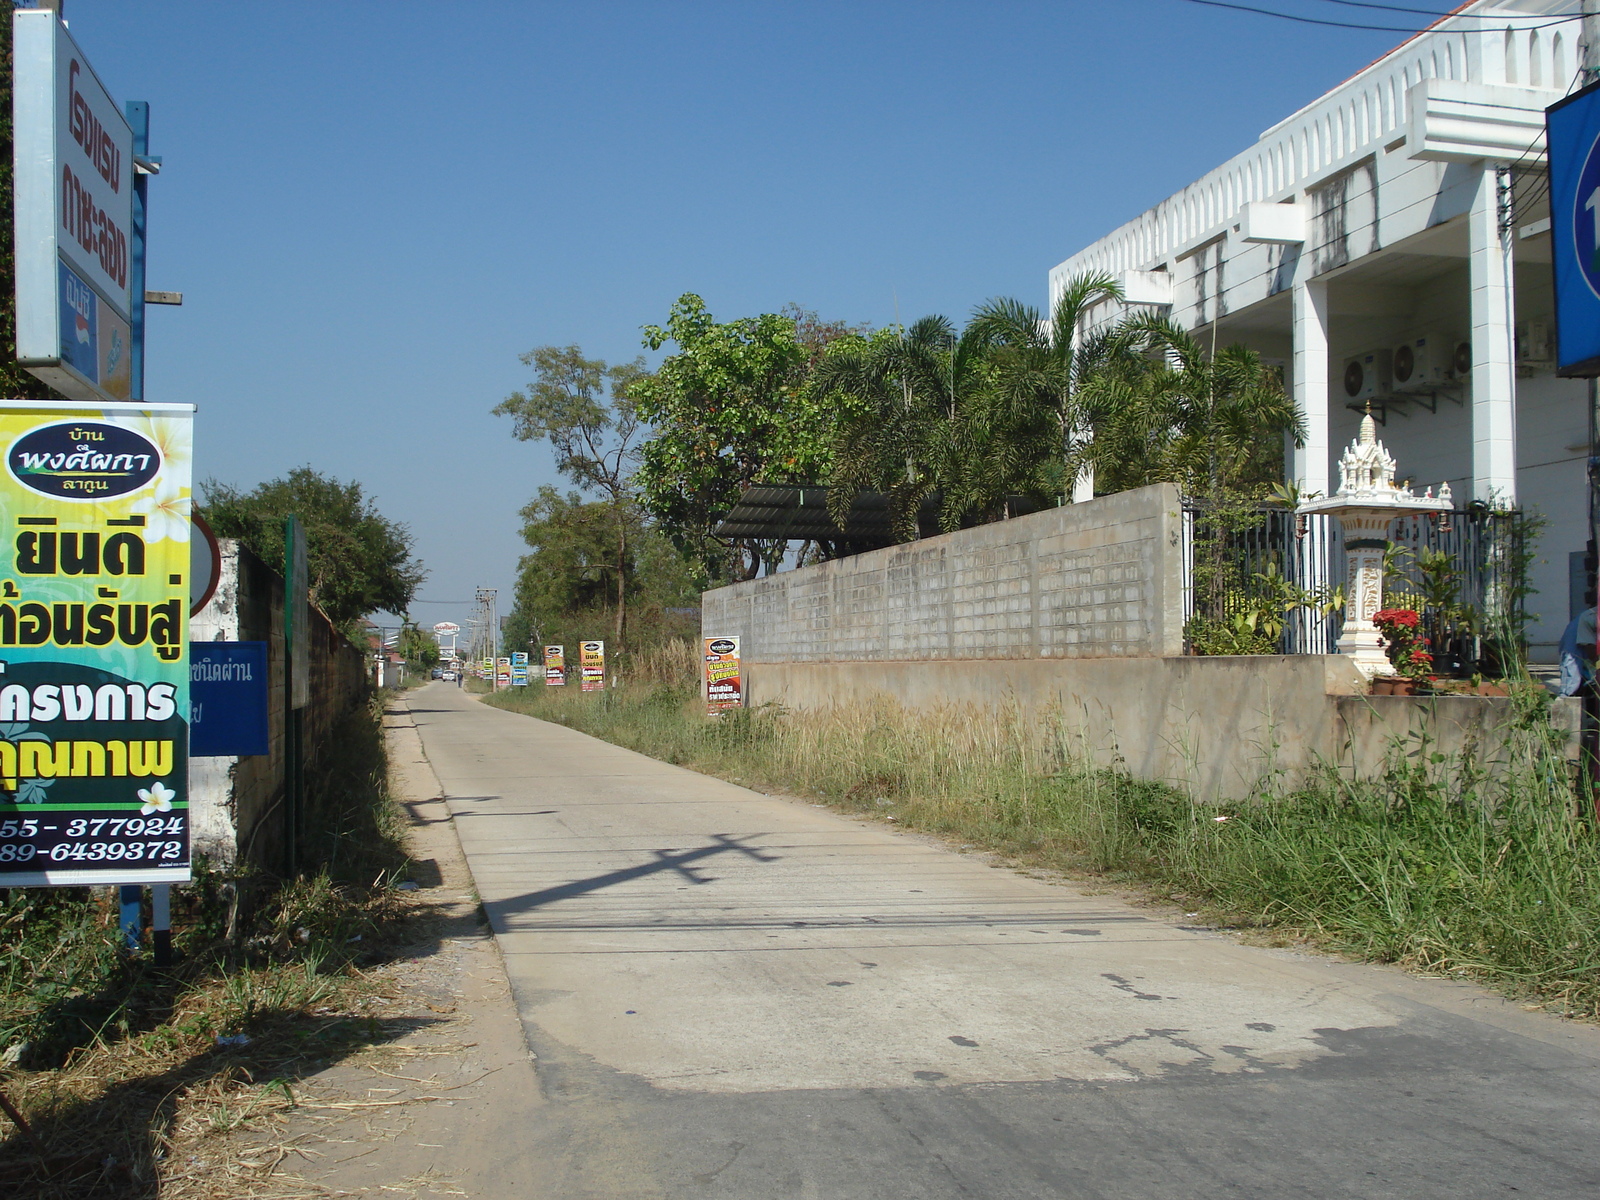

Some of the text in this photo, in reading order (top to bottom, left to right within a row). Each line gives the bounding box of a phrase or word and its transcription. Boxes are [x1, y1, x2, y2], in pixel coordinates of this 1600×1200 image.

[69, 58, 120, 194] โรงแรม
[68, 427, 105, 442] บ้าน
[62, 479, 109, 494] ลากูน
[16, 514, 146, 576] ยินดี
[0, 662, 176, 721] ครงการ
[66, 816, 184, 837] 377924
